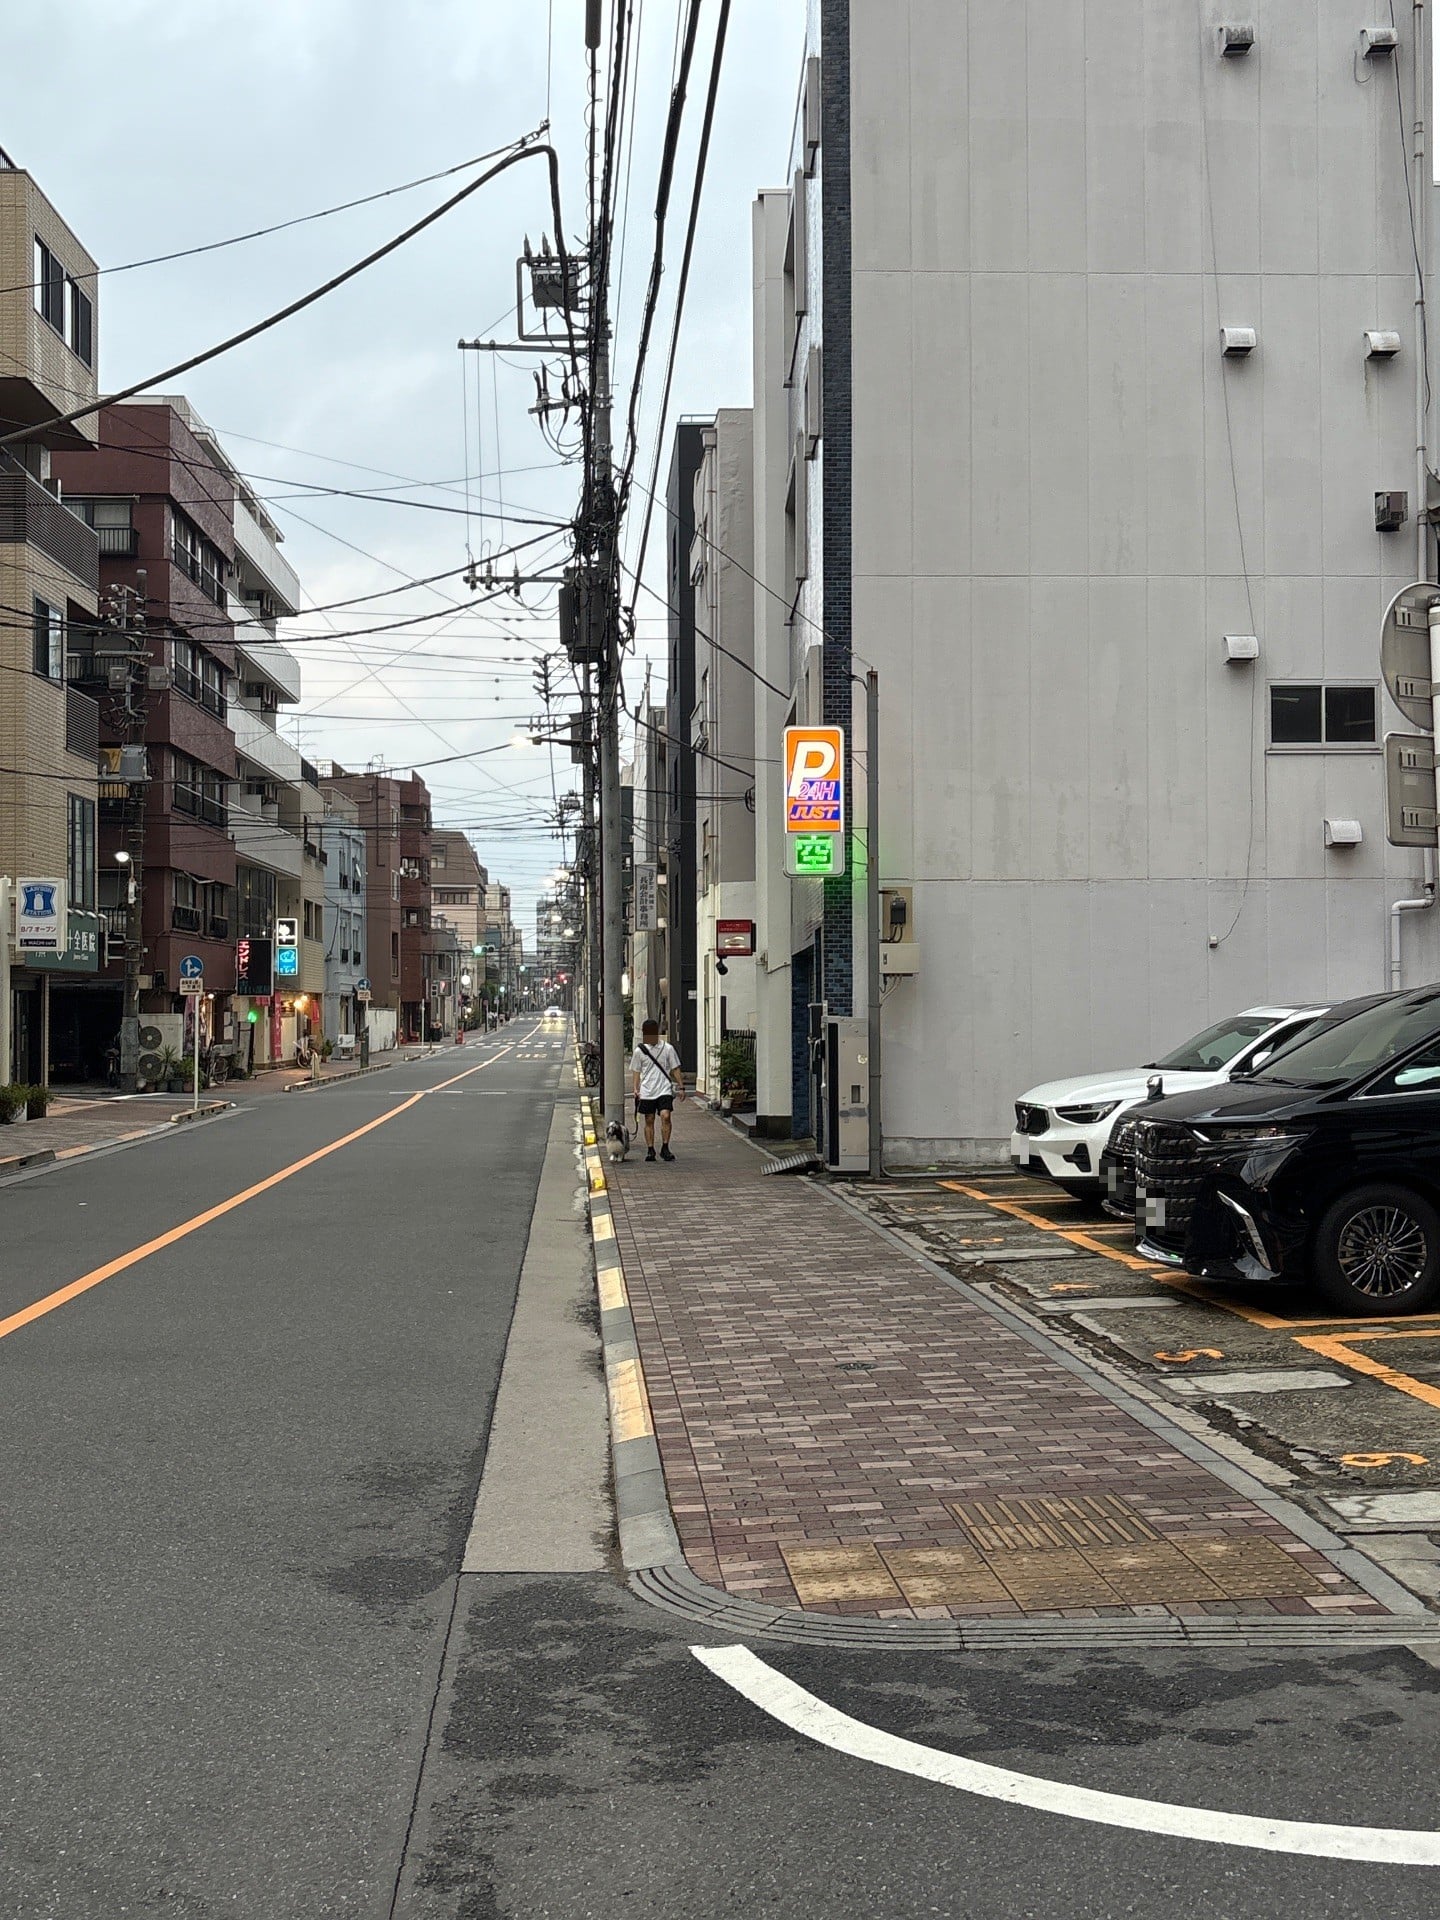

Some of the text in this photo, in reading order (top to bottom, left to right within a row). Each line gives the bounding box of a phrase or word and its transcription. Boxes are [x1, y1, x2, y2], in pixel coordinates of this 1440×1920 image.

[788, 741, 836, 798] P
[795, 782, 835, 801] 24H
[790, 805, 839, 820] JUST
[25, 886, 53, 894] LAWSON
[238, 941, 250, 980] エンドレス
[1152, 1348, 1226, 1363] 5
[1340, 1452, 1429, 1468] 6
